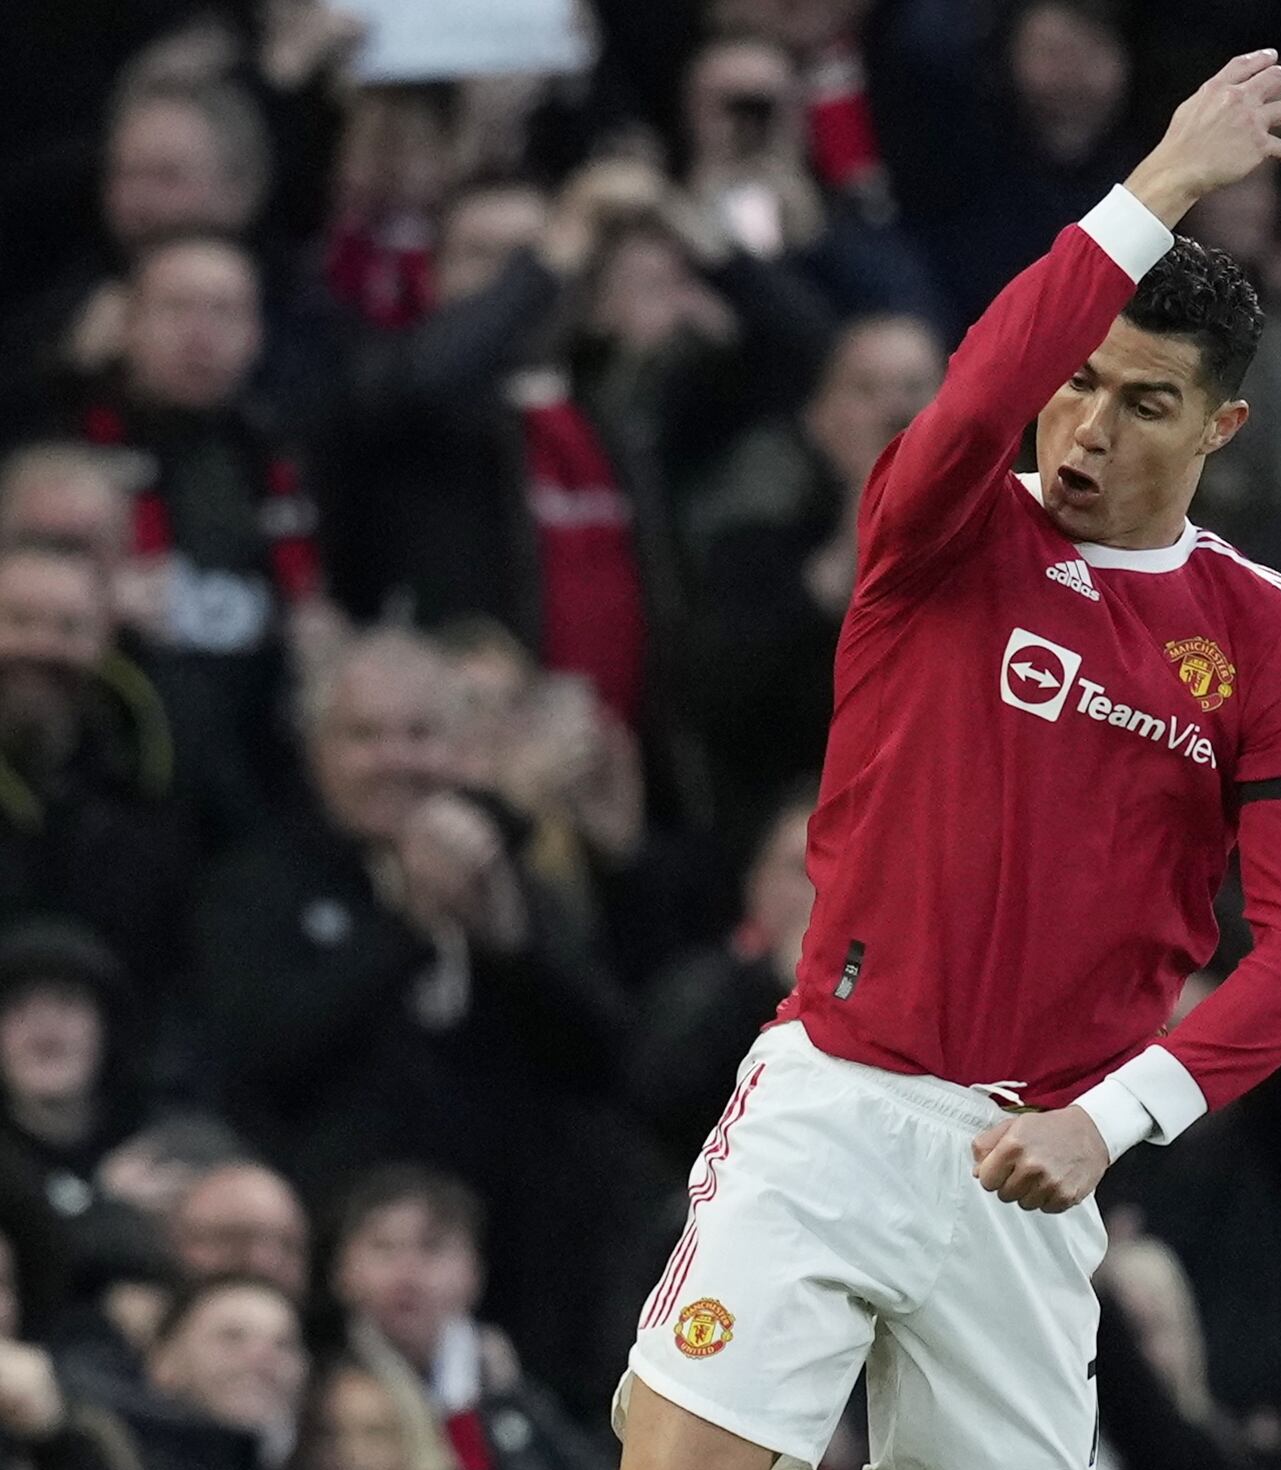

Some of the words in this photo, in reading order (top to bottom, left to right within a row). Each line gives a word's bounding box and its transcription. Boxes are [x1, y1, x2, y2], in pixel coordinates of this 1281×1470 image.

[1046, 566, 1100, 601] adidas
[1168, 640, 1230, 679] MANCHESTER
[1076, 677, 1217, 769] TeamVie
